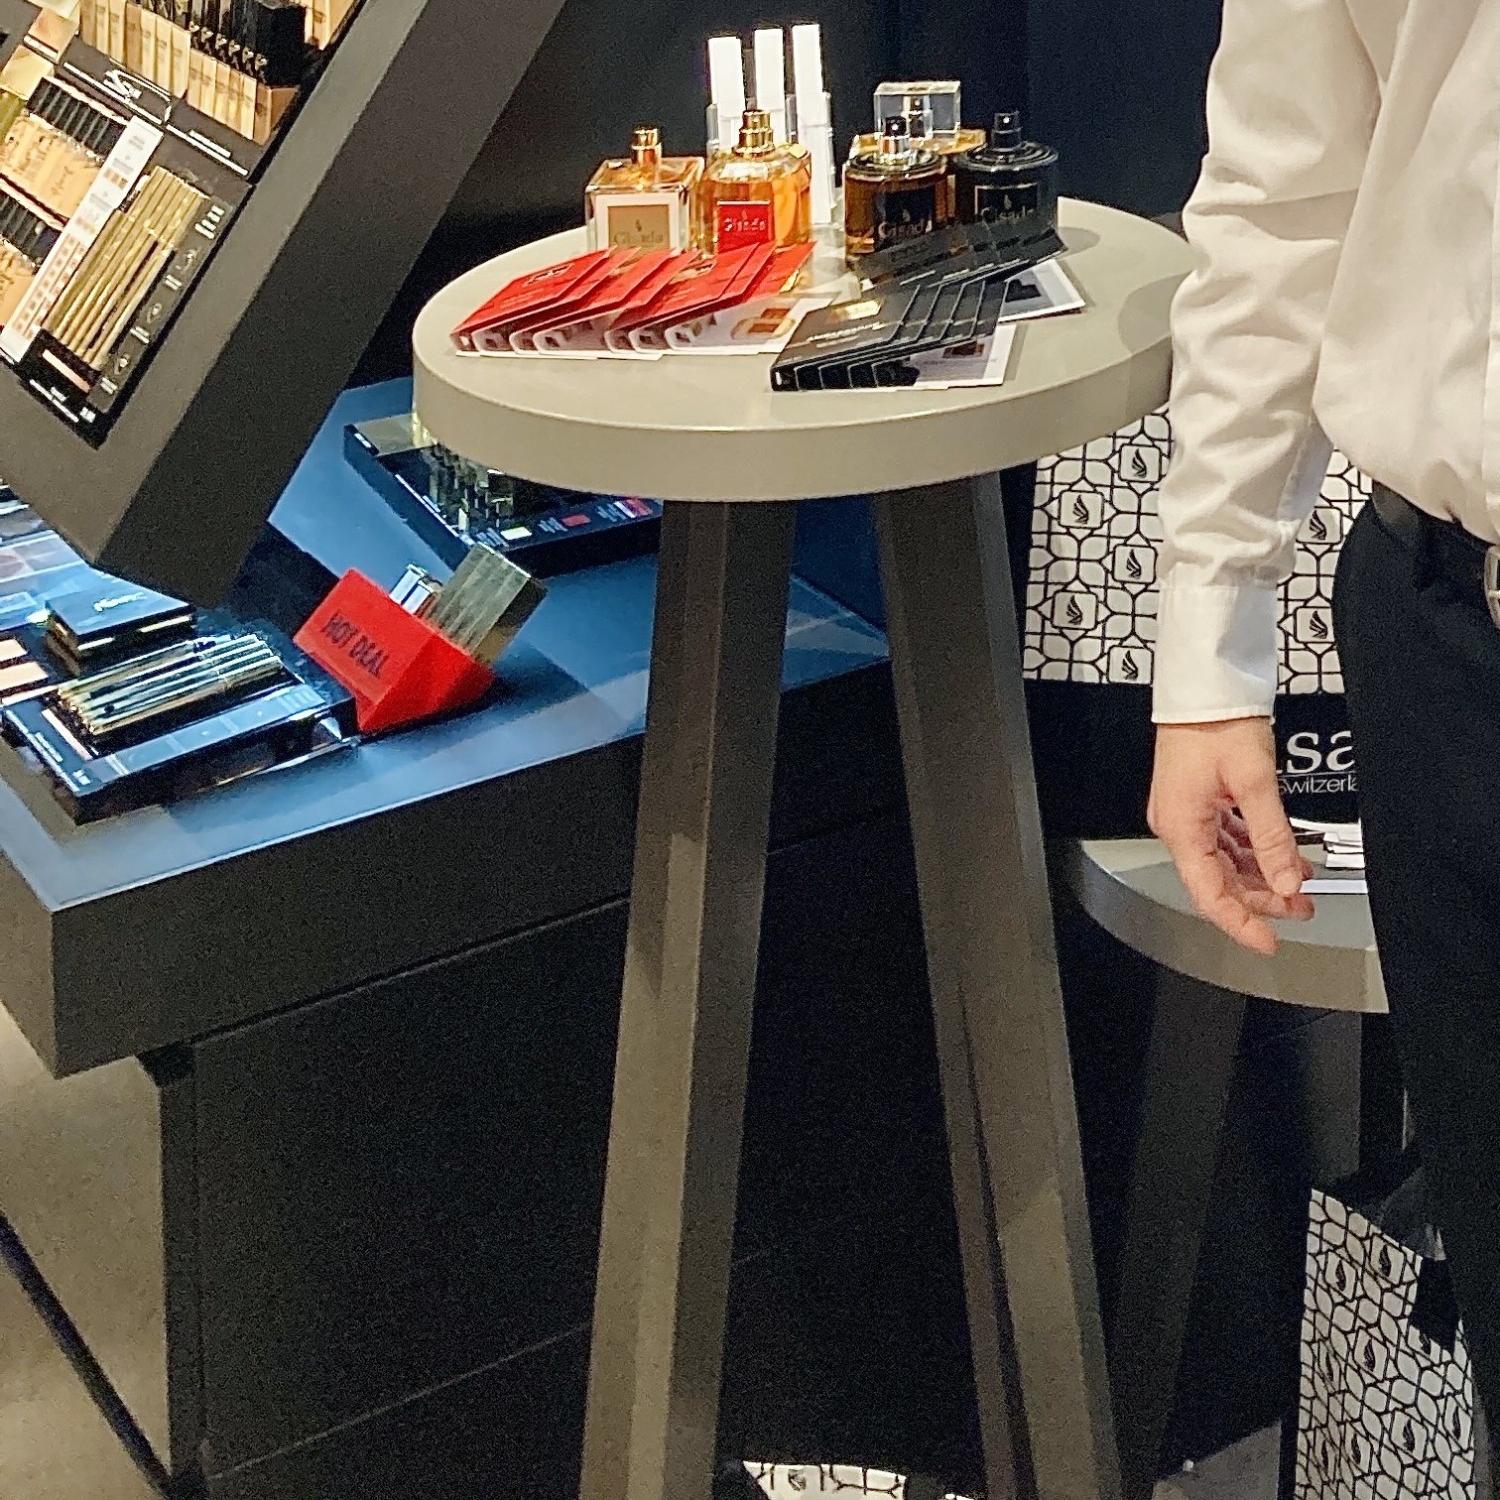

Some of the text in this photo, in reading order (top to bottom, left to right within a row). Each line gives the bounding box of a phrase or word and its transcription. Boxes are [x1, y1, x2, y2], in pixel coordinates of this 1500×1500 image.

[321, 609, 390, 678] HOT DEAL
[1286, 730, 1356, 774] sa
